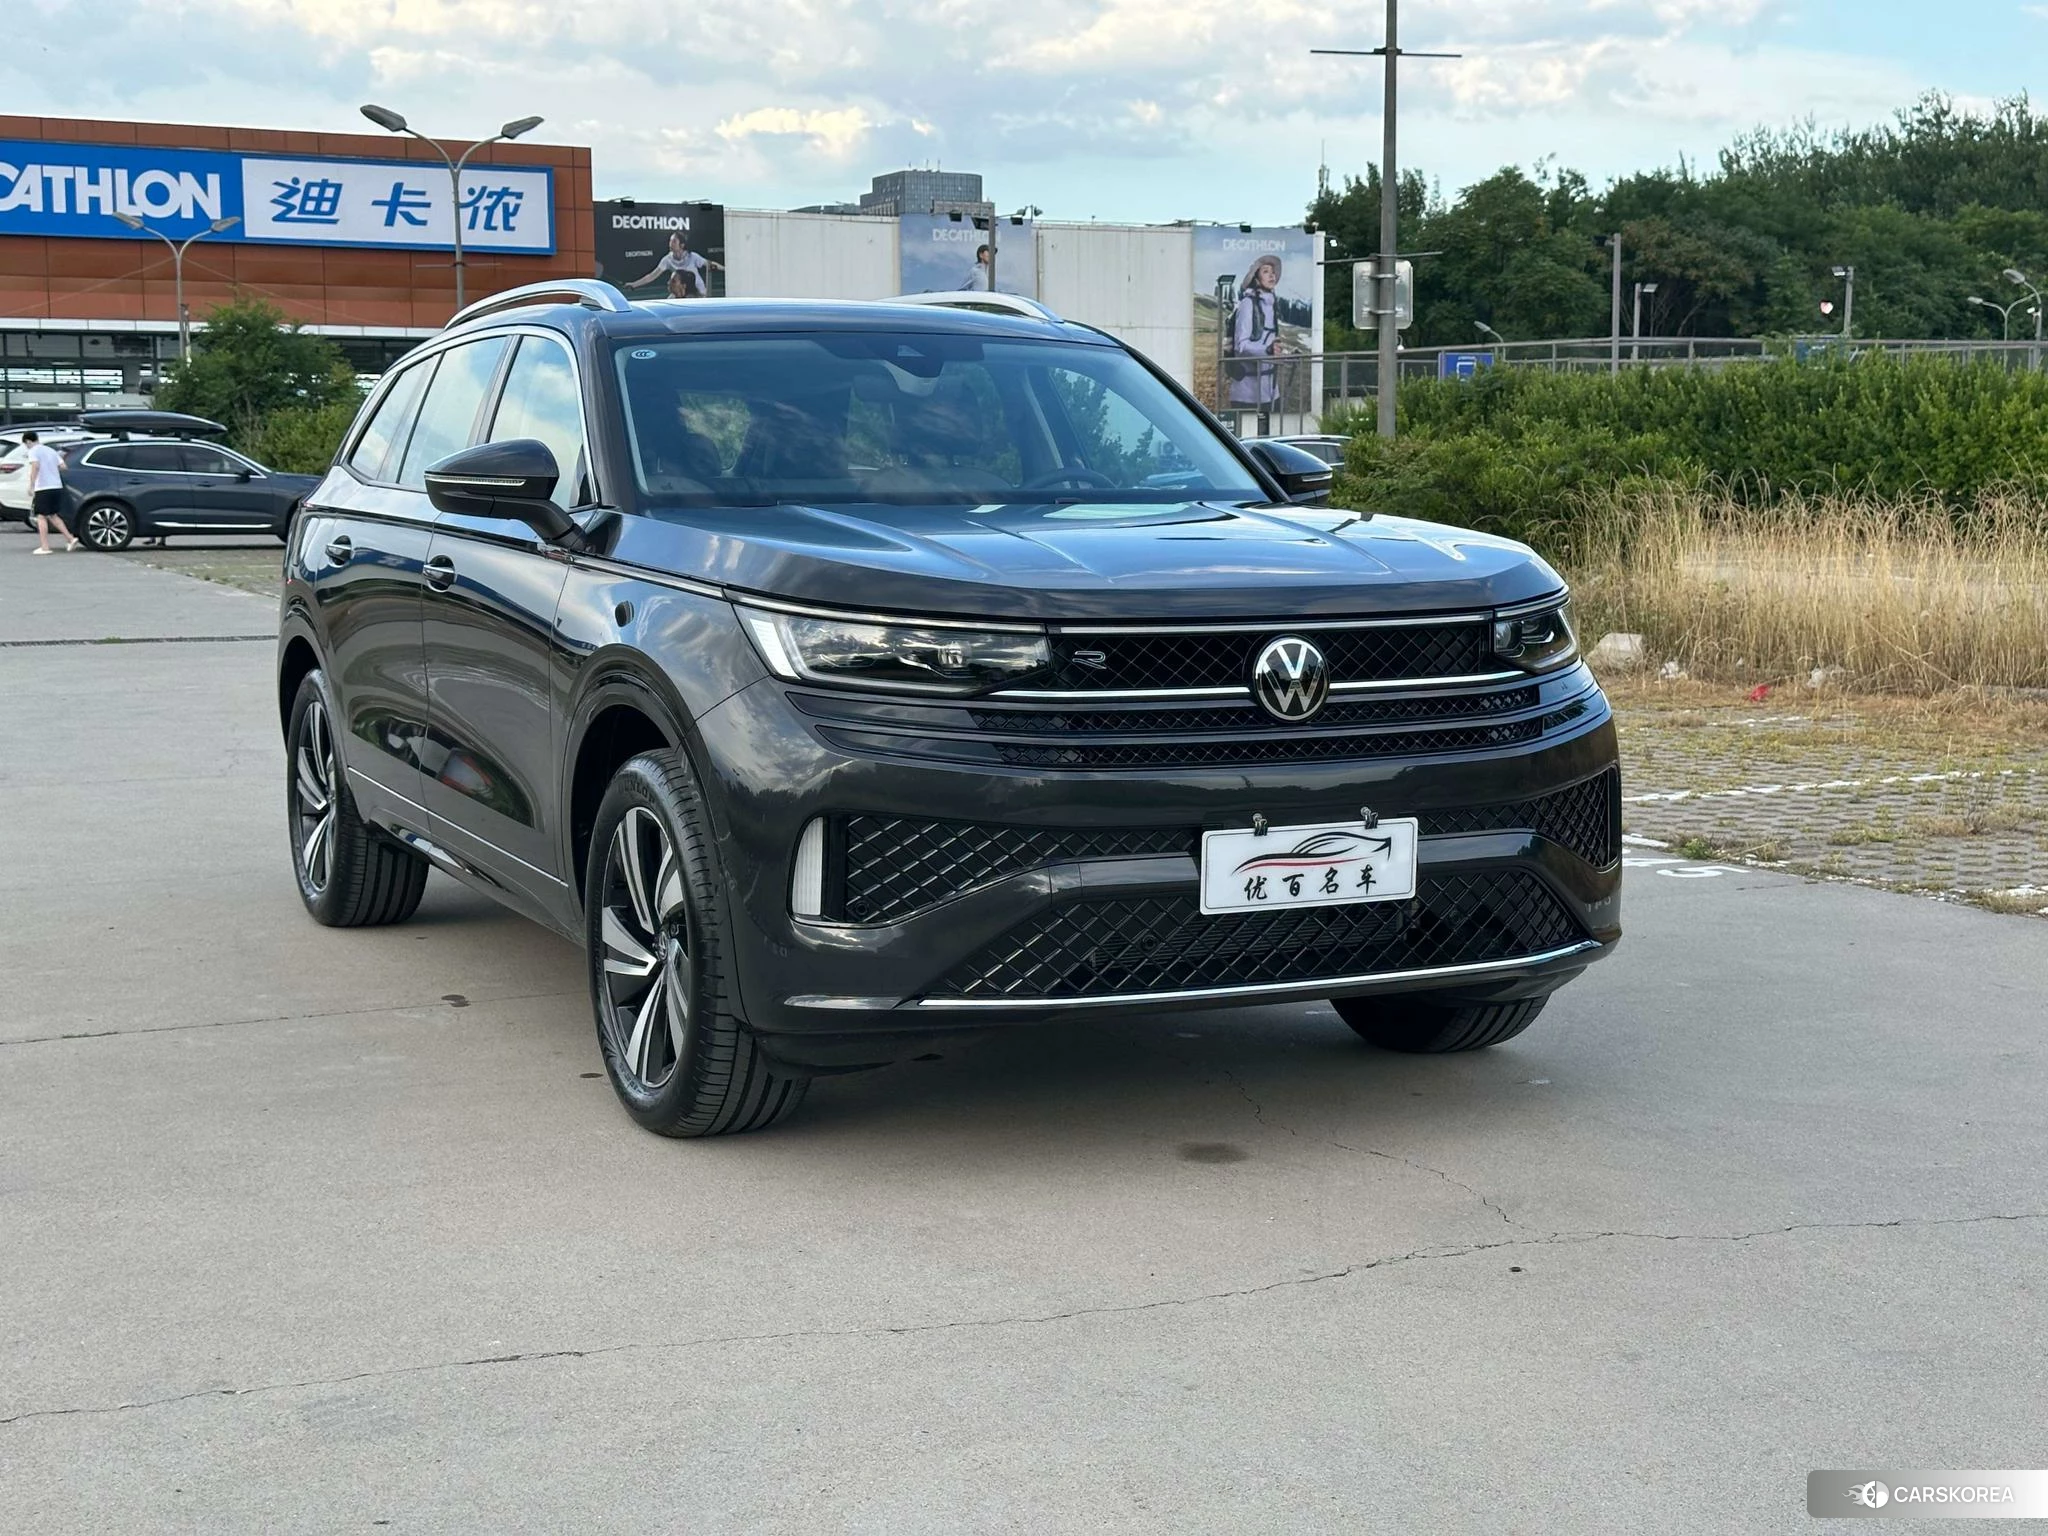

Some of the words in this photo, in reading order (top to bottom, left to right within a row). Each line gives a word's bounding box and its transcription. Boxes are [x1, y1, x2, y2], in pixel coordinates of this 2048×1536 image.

[270, 176, 524, 232] 迪卡侬
[612, 215, 690, 231] DECATHLON
[1244, 864, 1377, 901] 优百名车
